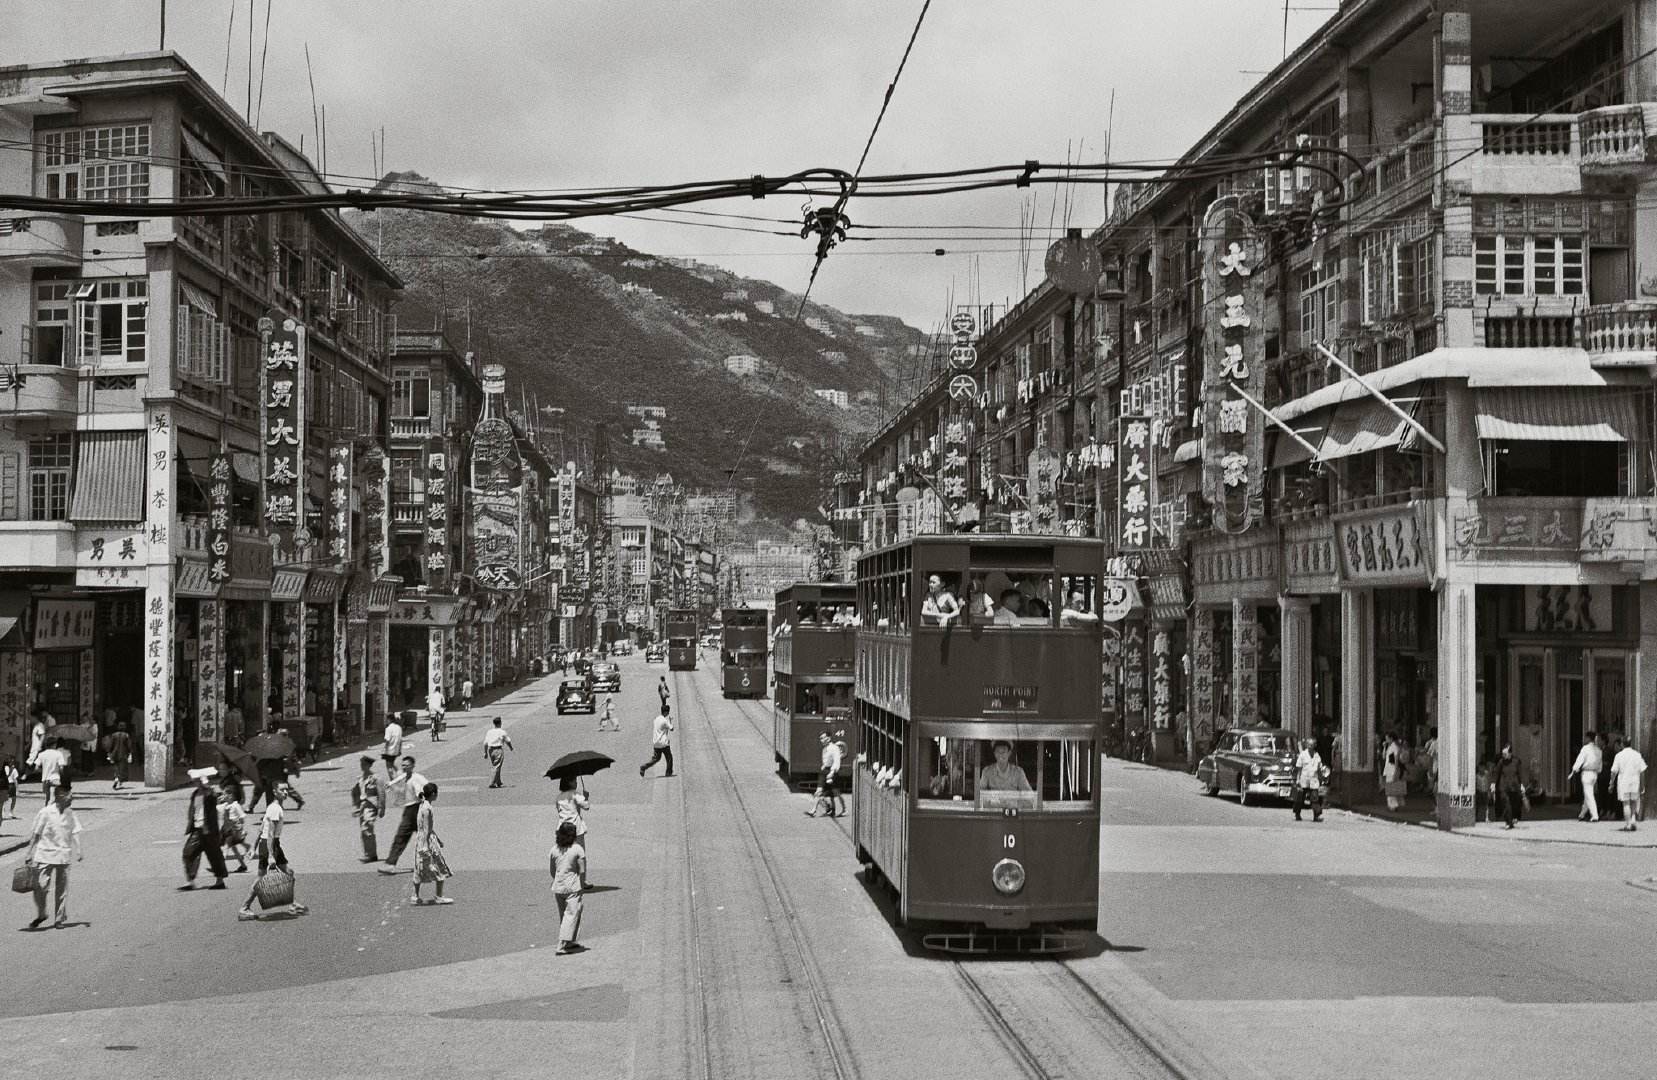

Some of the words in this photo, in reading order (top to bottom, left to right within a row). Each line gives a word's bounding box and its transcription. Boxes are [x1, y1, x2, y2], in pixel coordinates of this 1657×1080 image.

[266, 341, 298, 522] 英男大茶樓
[90, 537, 137, 561] 英男
[1003, 833, 1016, 849] 10
